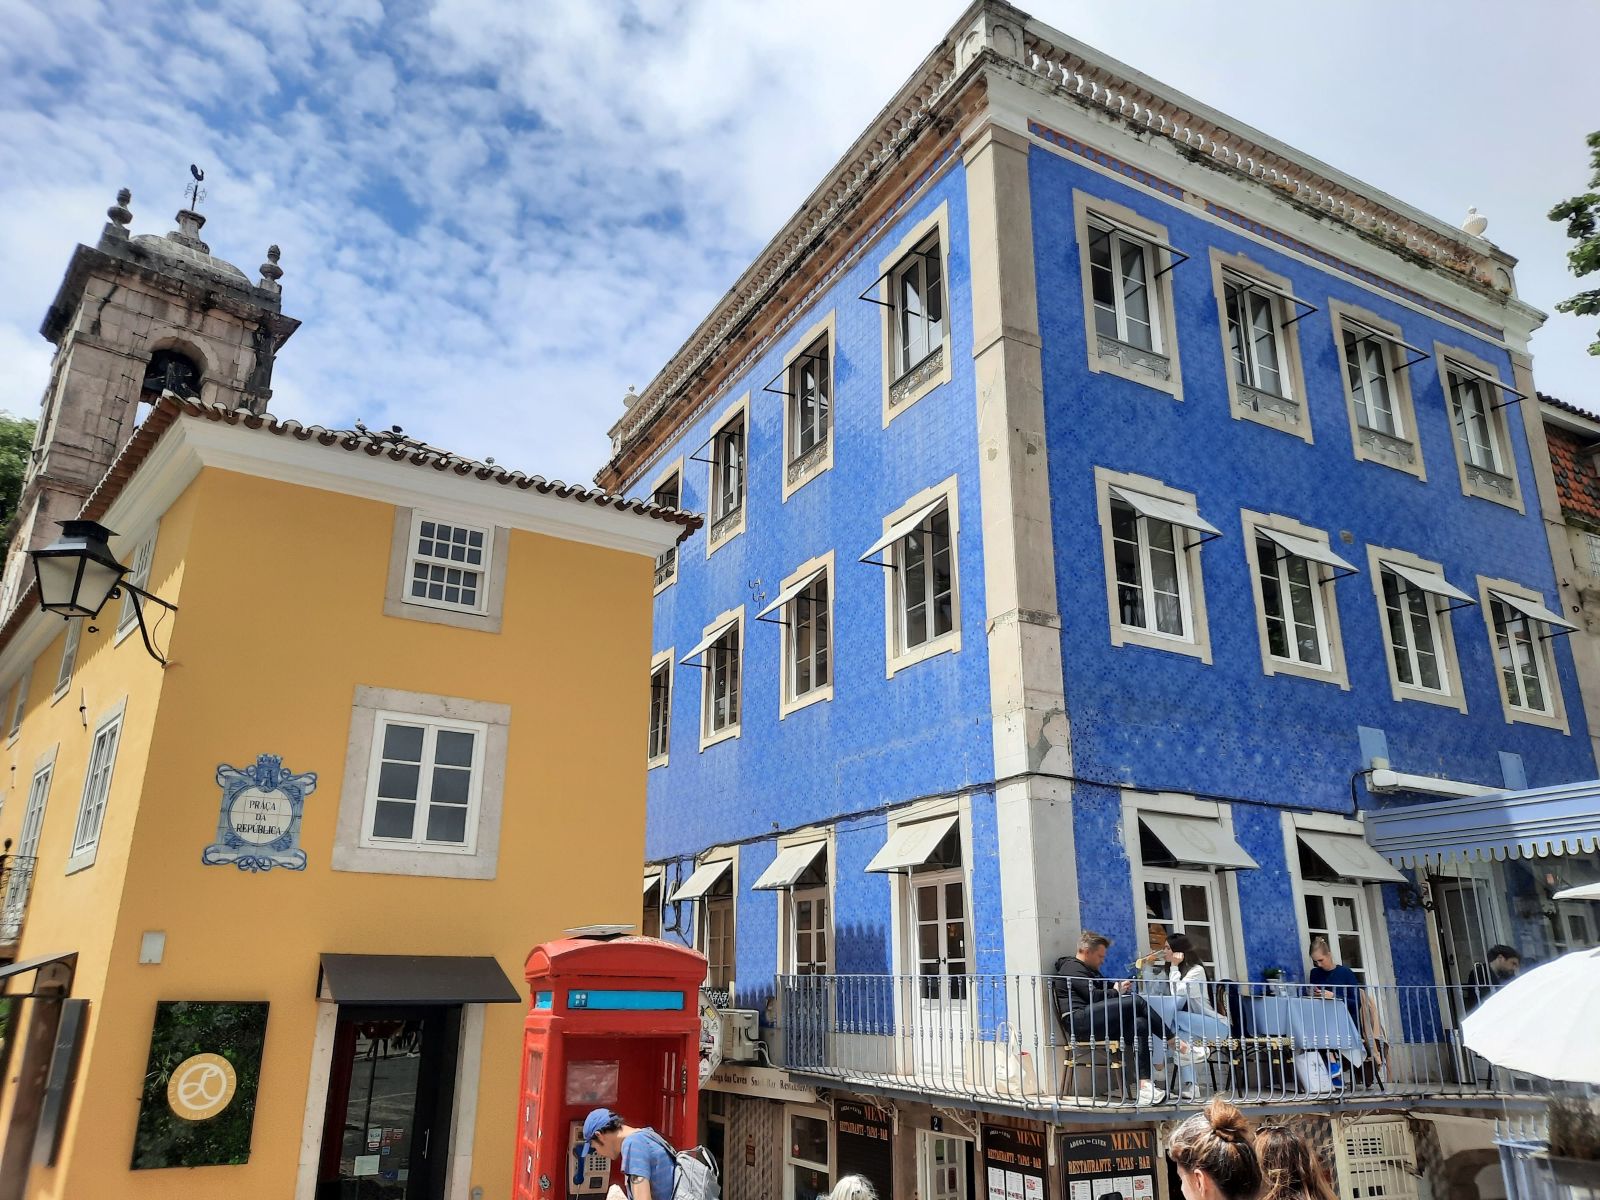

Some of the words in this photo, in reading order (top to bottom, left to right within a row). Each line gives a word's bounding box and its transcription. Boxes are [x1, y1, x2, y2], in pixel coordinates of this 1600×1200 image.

[249, 800, 276, 811] PRAÇA
[255, 813, 266, 821] DA
[236, 823, 281, 836] REPÚBLICA
[1015, 1130, 1042, 1147] MENU
[1110, 1131, 1150, 1151] MENU
[1067, 1158, 1112, 1175] RESTAURANTE
[1115, 1156, 1135, 1171] TAPAS
[1138, 1155, 1152, 1170] BAR
